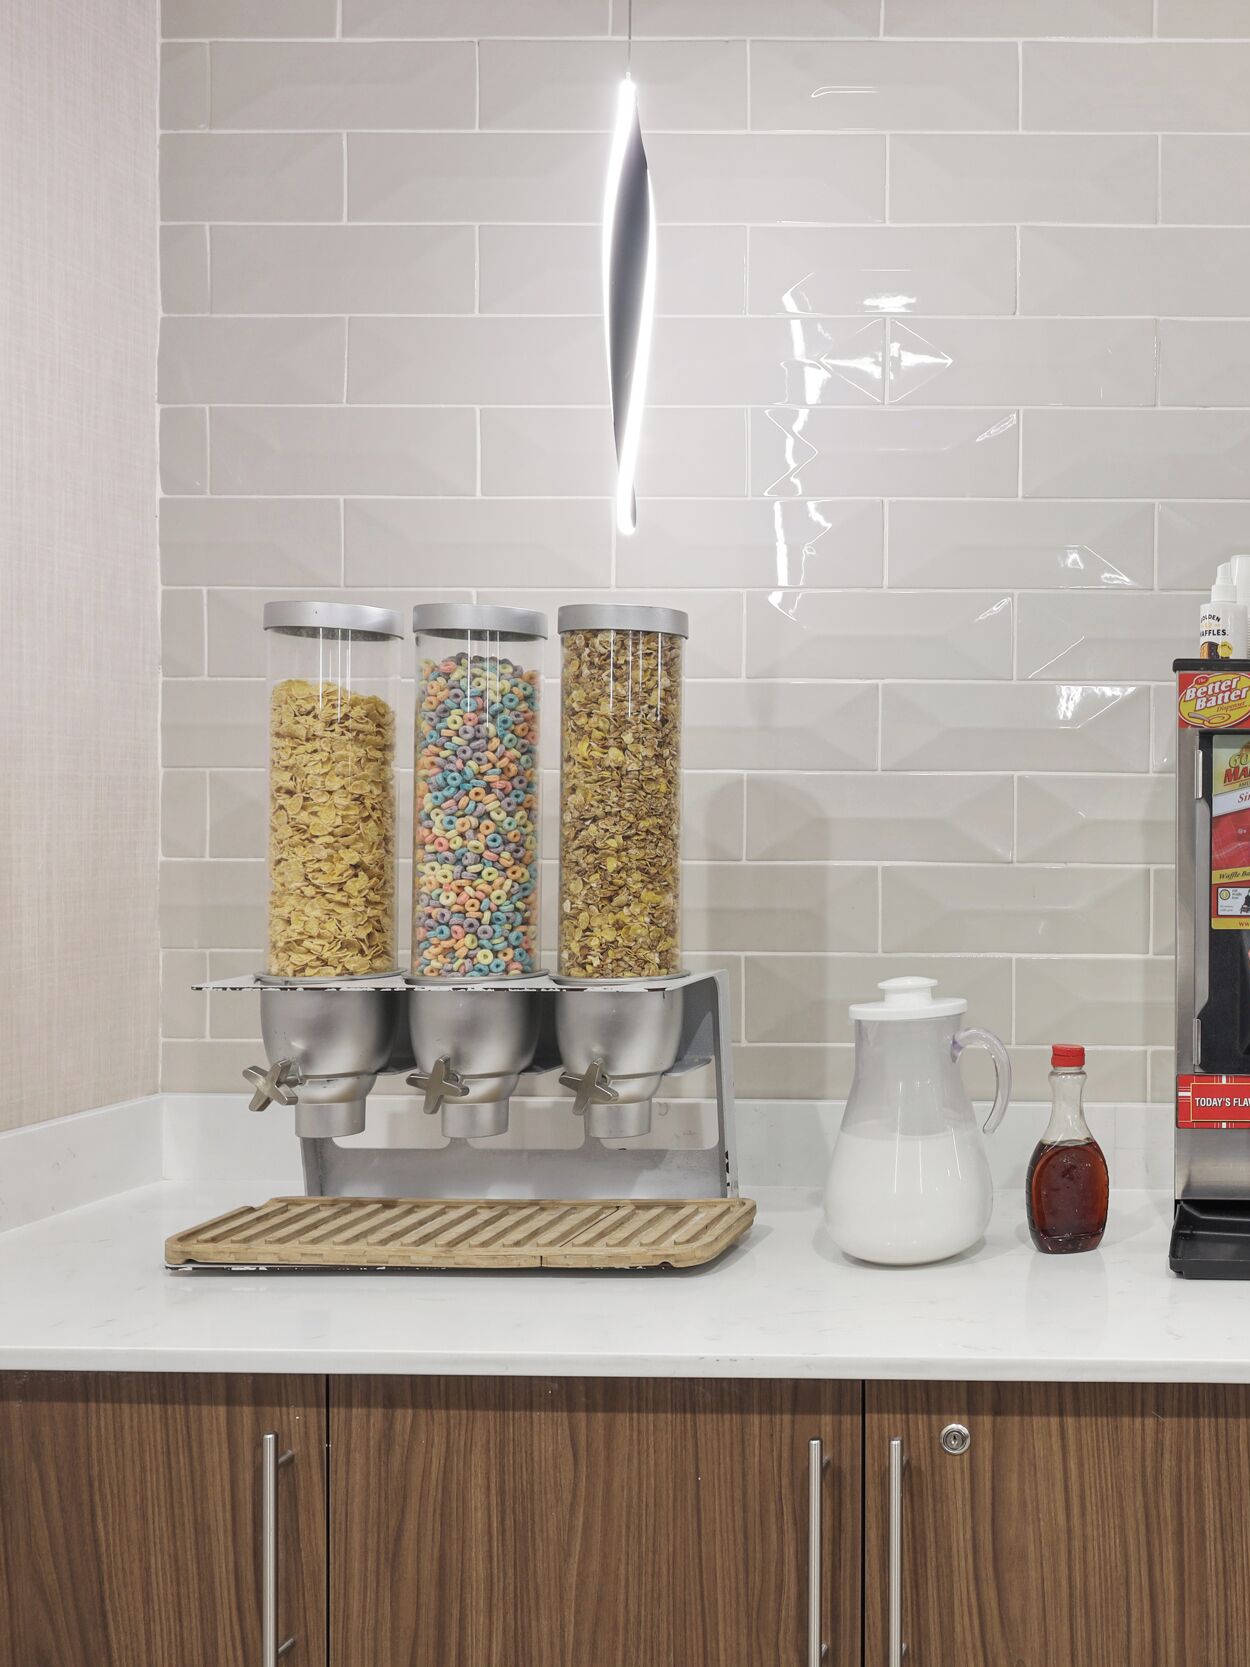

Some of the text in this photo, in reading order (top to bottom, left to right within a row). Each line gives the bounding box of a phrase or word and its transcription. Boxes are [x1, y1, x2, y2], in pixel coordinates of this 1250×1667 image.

[1184, 676, 1241, 702] Better
[1194, 686, 1250, 711] Batter
[1218, 871, 1241, 880] Waffle
[1194, 1097, 1231, 1108] TODAY'S
